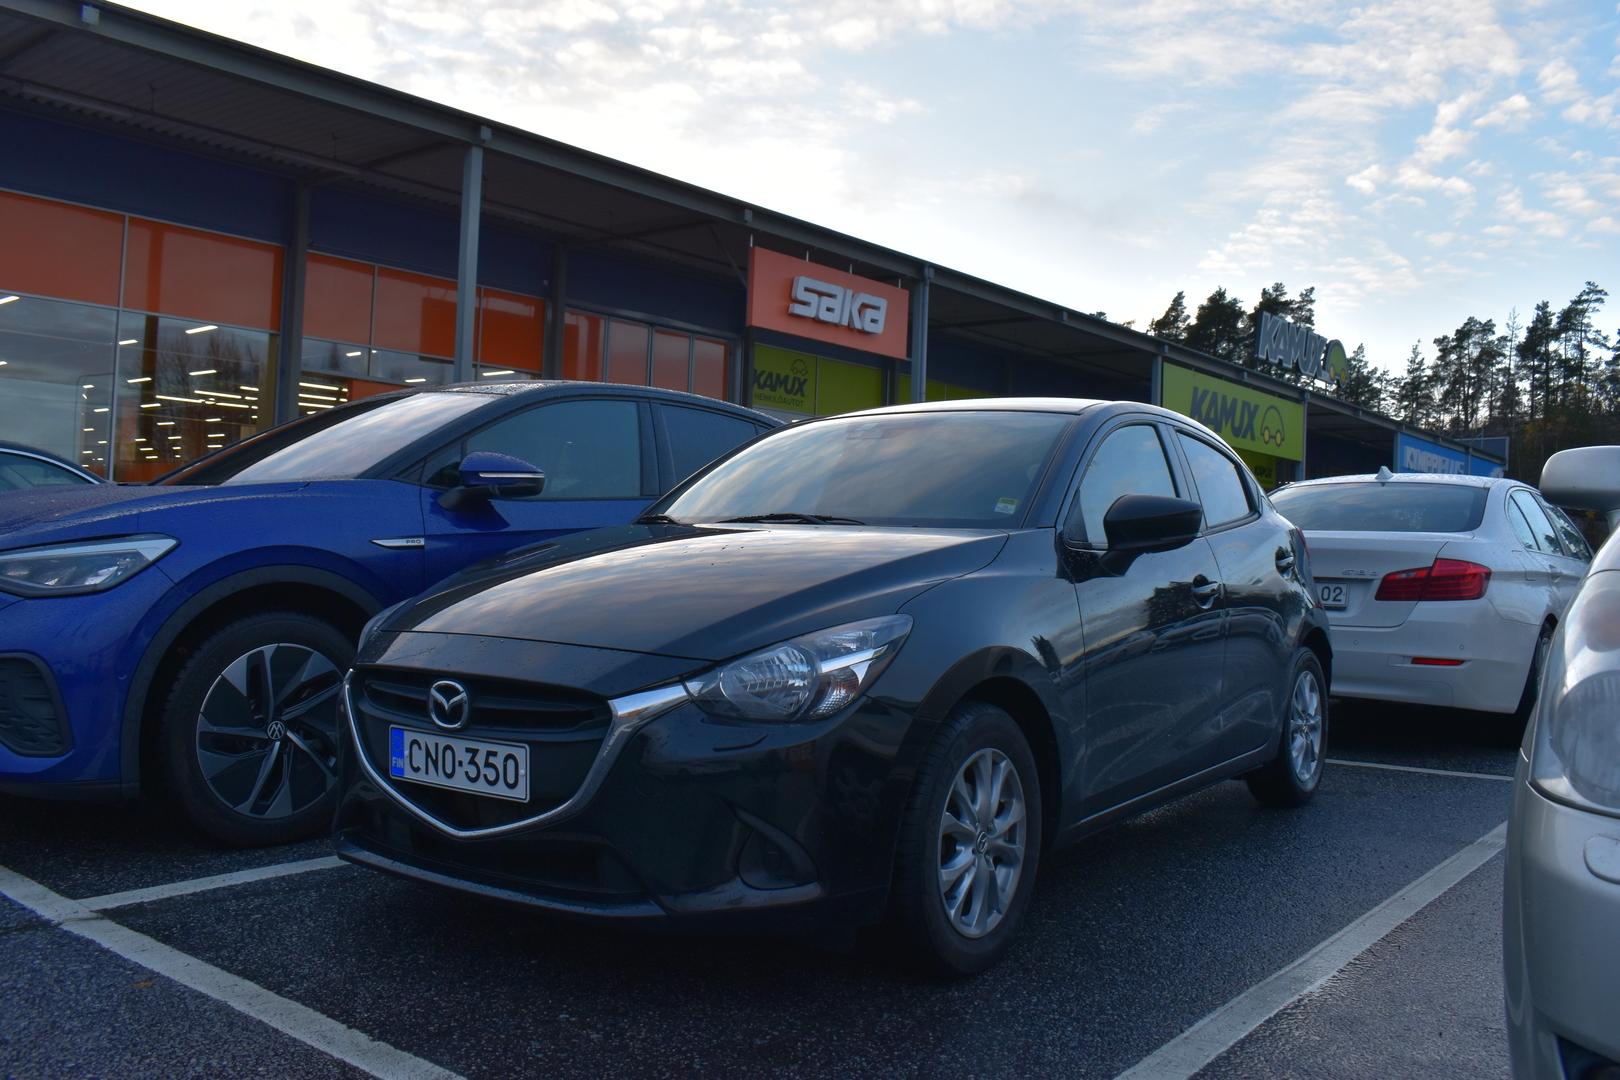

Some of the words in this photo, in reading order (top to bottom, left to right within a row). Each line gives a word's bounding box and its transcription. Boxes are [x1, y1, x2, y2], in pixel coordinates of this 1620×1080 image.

[1257, 310, 1328, 378] KAMUX
[753, 369, 808, 397] KAMUX
[754, 392, 804, 407] HENKILÖAUTOT
[1190, 386, 1260, 441] KAMUX
[1320, 586, 1343, 602] 02
[392, 757, 404, 768] FIN
[409, 738, 519, 790] CNO-350
